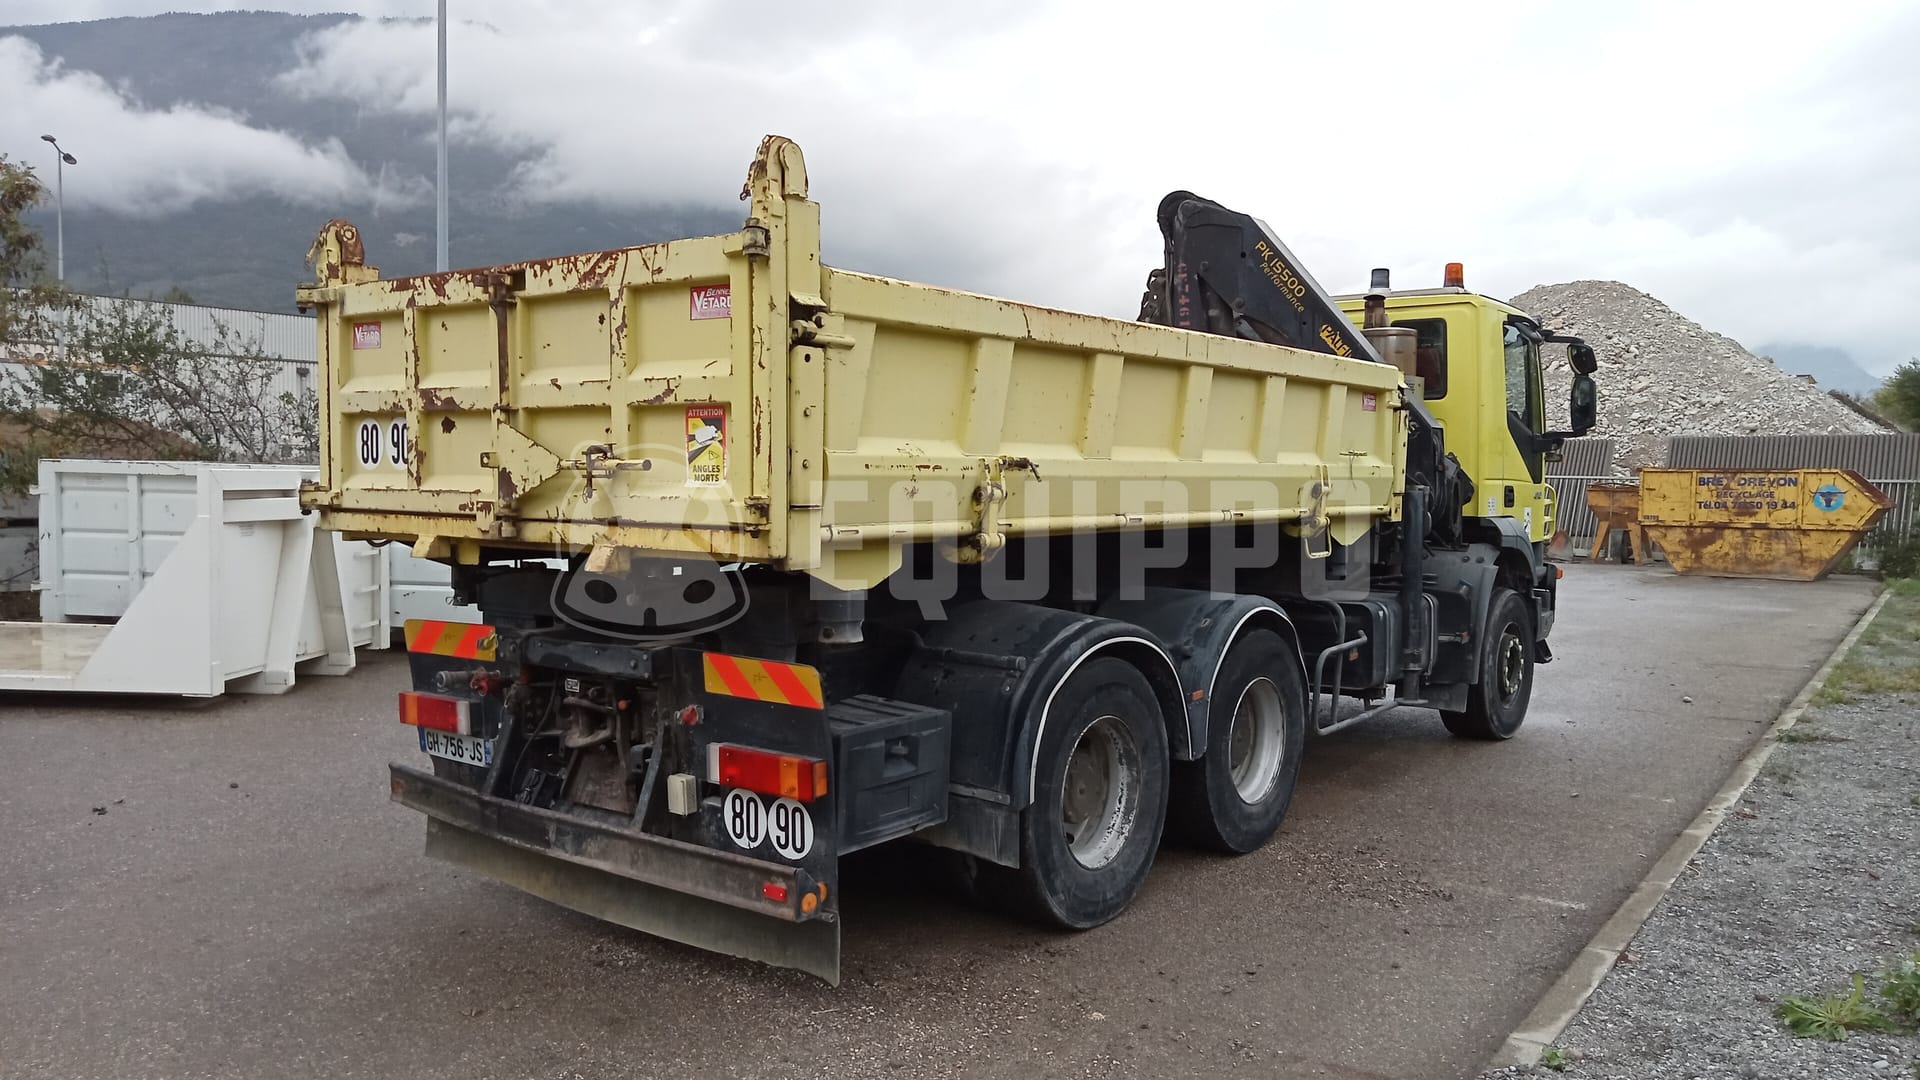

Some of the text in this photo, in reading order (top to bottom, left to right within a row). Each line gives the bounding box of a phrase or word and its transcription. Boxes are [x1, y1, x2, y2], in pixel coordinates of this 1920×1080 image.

[1255, 241, 1274, 261] PK
[1259, 262, 1305, 313] Performance
[688, 408, 724, 417] ATTENTION
[361, 423, 379, 464] 80
[692, 464, 721, 473] ANGLES
[693, 474, 720, 482] MORTS
[426, 731, 483, 763] GH-756-JS
[732, 794, 806, 854] 80 90
